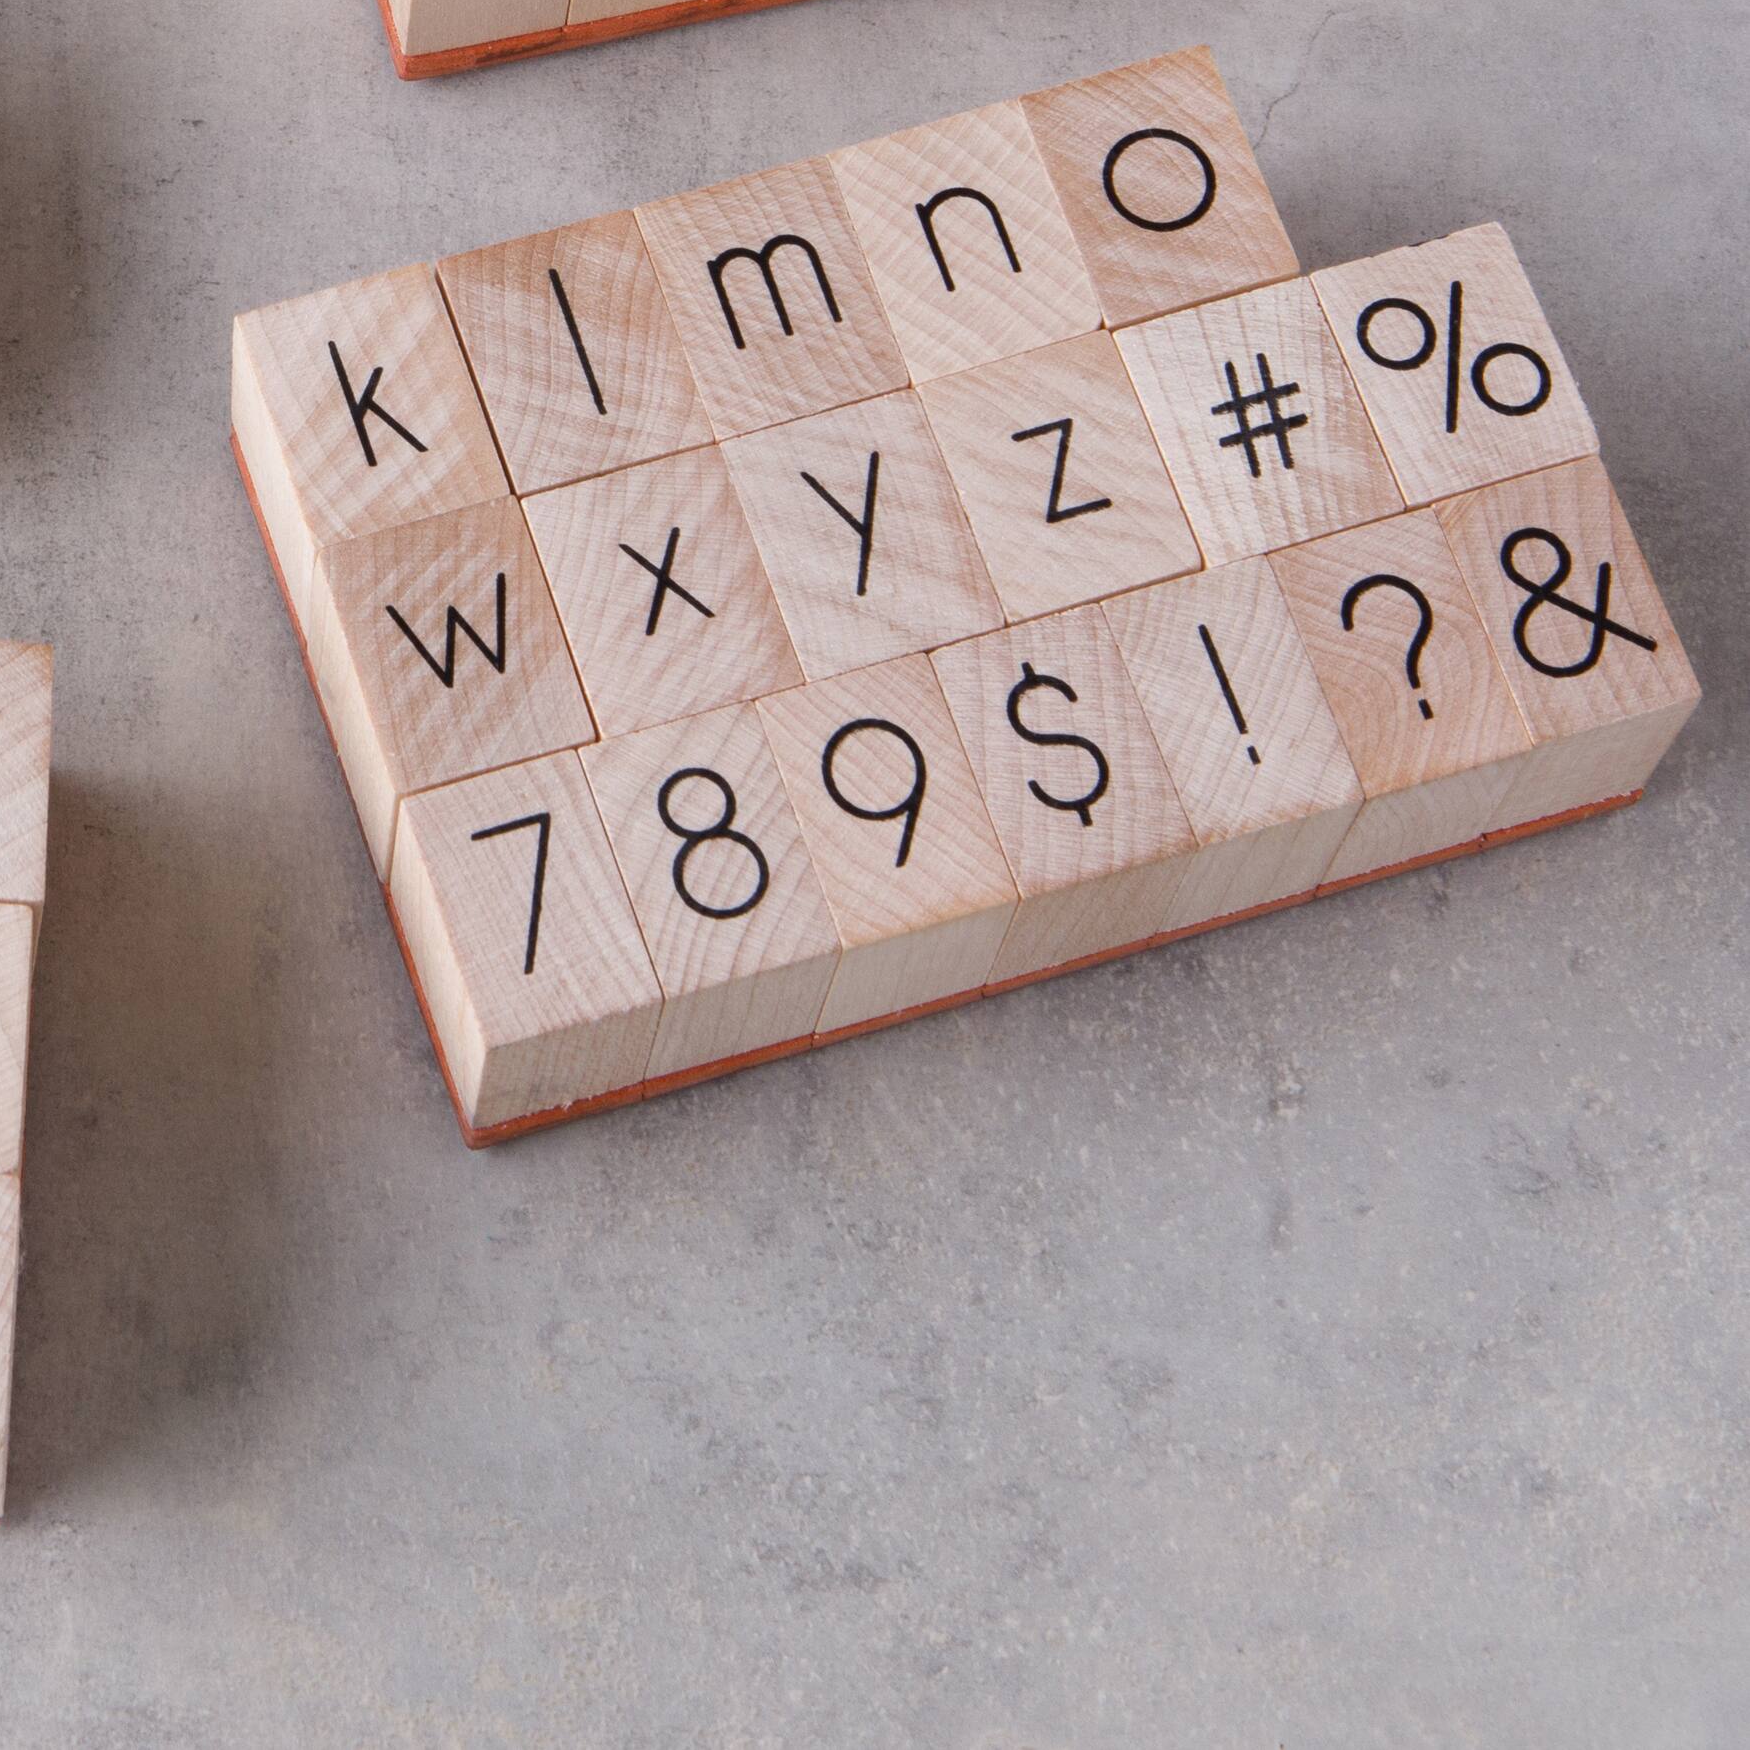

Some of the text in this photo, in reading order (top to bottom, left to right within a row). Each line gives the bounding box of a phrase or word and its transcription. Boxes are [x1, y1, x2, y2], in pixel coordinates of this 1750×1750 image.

[328, 340, 428, 467] k
[706, 234, 843, 350] m
[915, 187, 1022, 292] n
[1102, 128, 1217, 233] o
[385, 280, 1552, 689] w x y z # %
[471, 527, 1658, 975] 7 8 9 $ ! ? &
